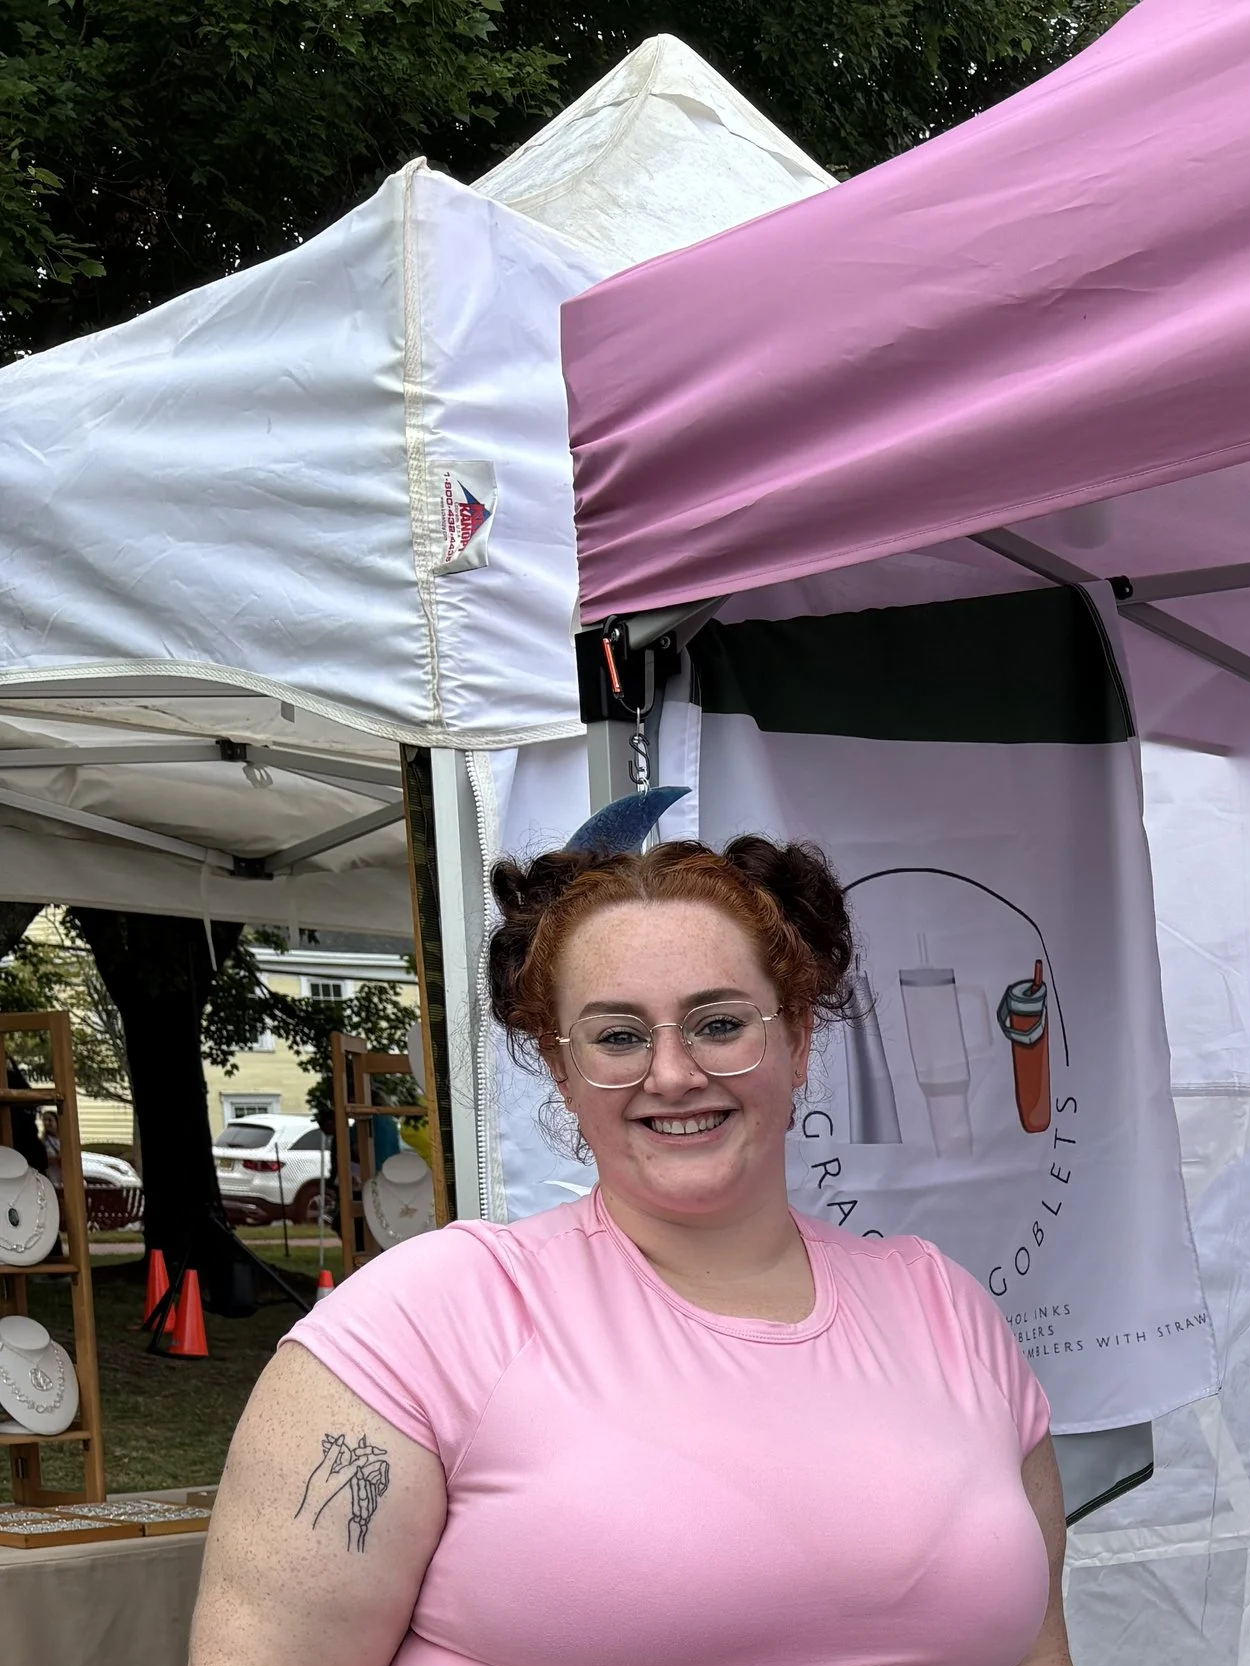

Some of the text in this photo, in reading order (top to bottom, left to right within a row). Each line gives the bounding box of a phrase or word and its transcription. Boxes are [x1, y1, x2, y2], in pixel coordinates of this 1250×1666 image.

[802, 1111, 884, 1238] GRA
[988, 1096, 1078, 1296] GOBLETS
[1014, 1325, 1055, 1343] BLERS
[1022, 1312, 1208, 1359] MBLERS WITH STRAW
[1034, 1304, 1071, 1320] INKS
